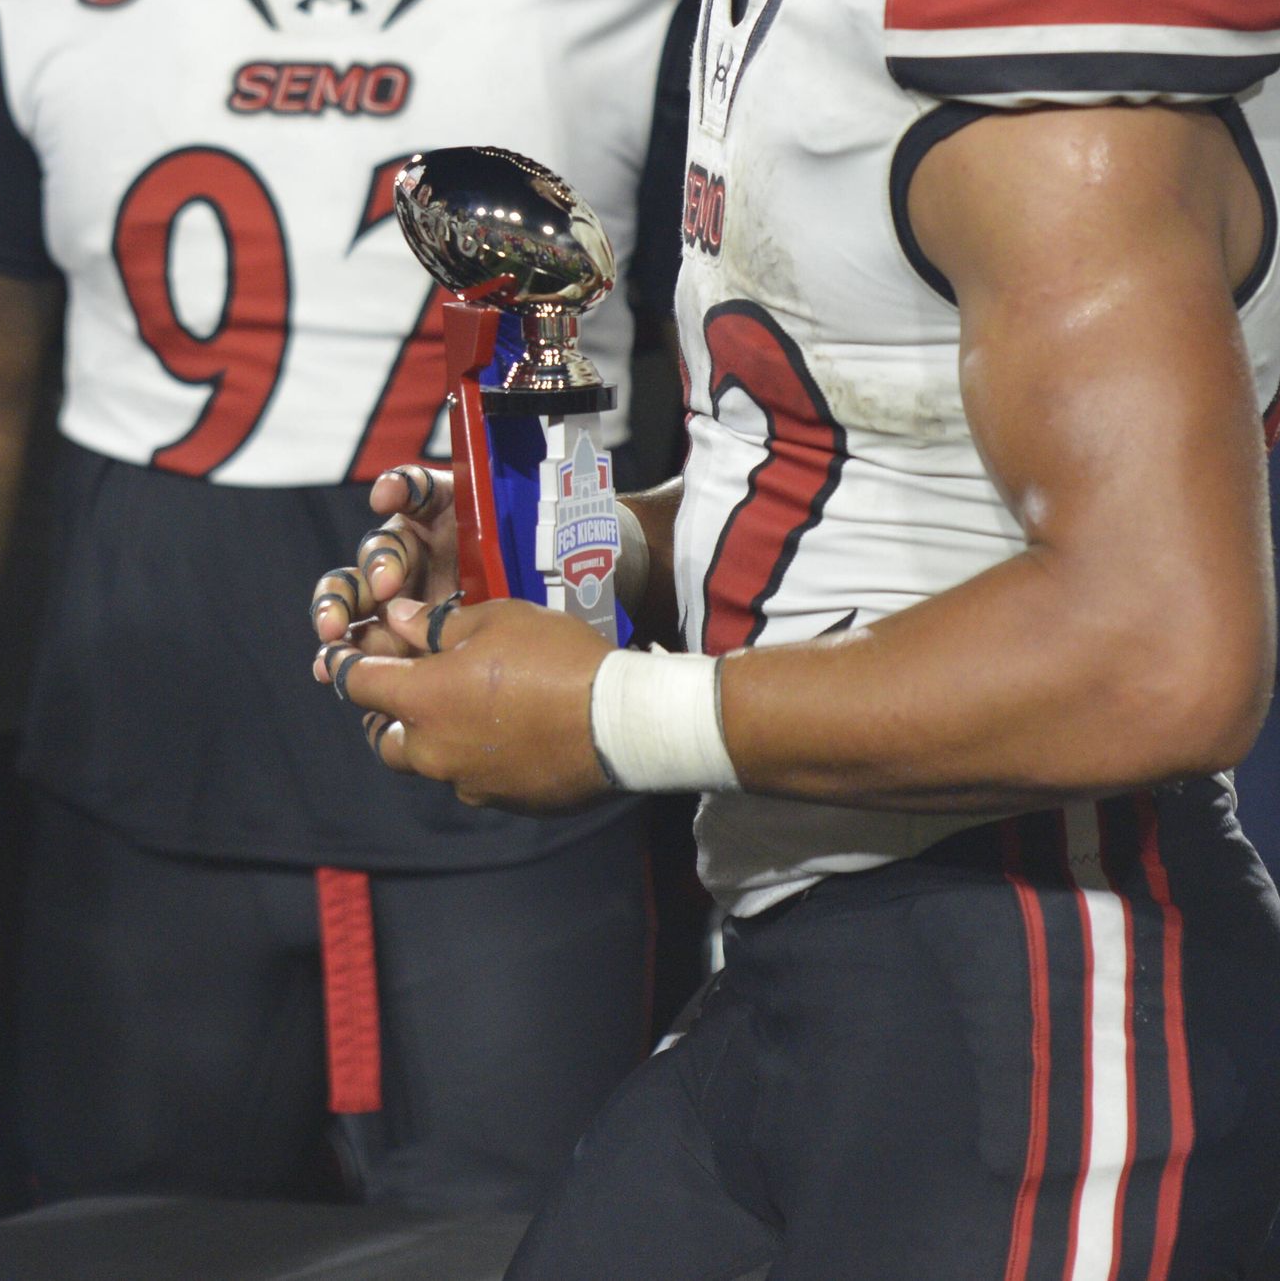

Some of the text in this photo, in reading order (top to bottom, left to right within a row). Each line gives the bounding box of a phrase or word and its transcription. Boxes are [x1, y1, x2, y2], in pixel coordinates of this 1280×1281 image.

[227, 59, 412, 117] SEMO
[683, 162, 726, 257] EMO
[558, 518, 617, 556] FCS KICKOFF
